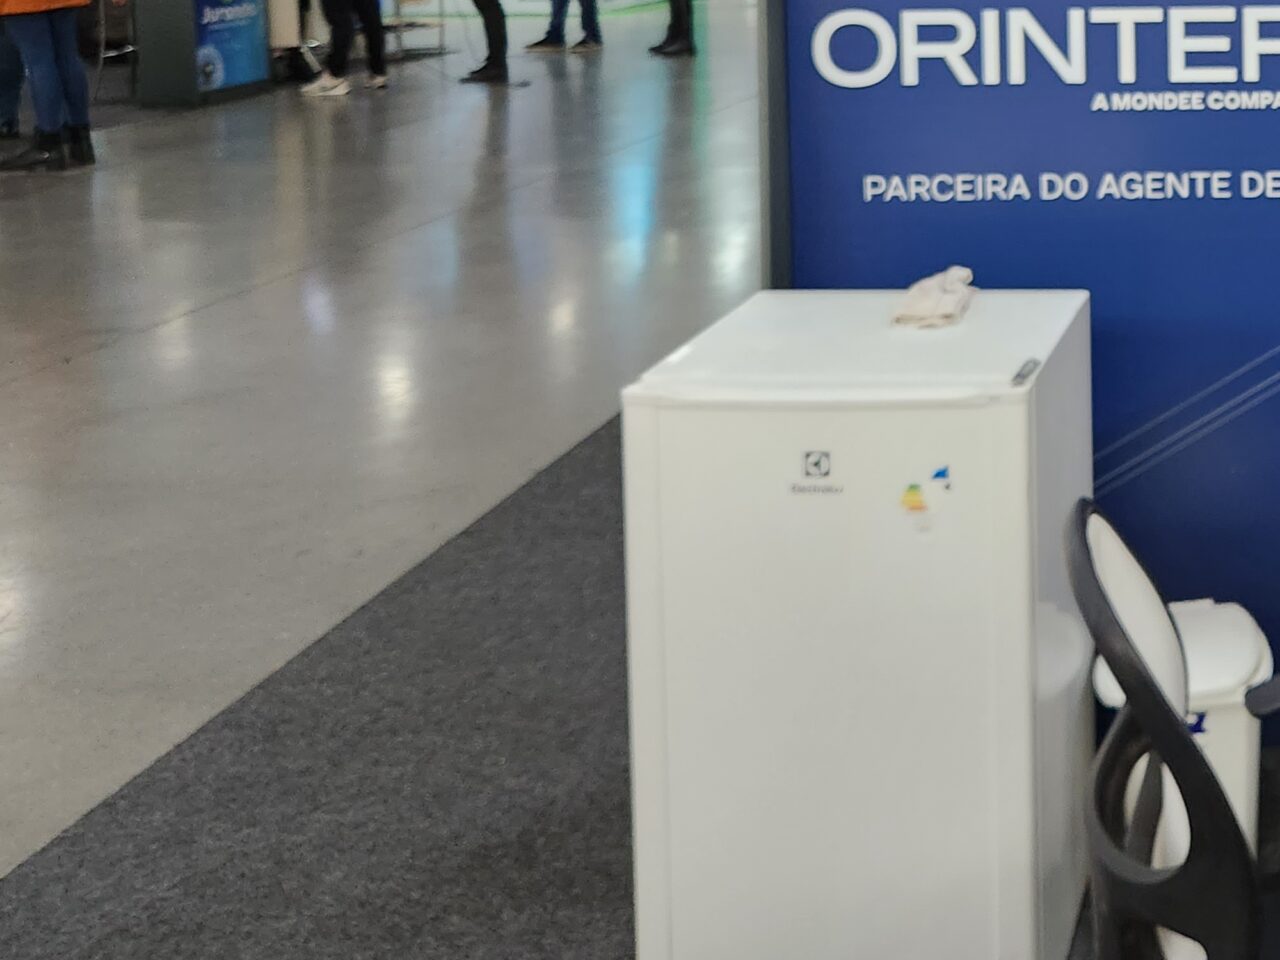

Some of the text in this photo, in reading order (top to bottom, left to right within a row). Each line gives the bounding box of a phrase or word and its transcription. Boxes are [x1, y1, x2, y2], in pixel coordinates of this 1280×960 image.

[1091, 93, 1109, 111] A
[1111, 92, 1205, 111] MONDEE
[863, 174, 1031, 202] PARCEIRA
[1038, 172, 1088, 201] DO
[1097, 171, 1231, 200] AGENTE
